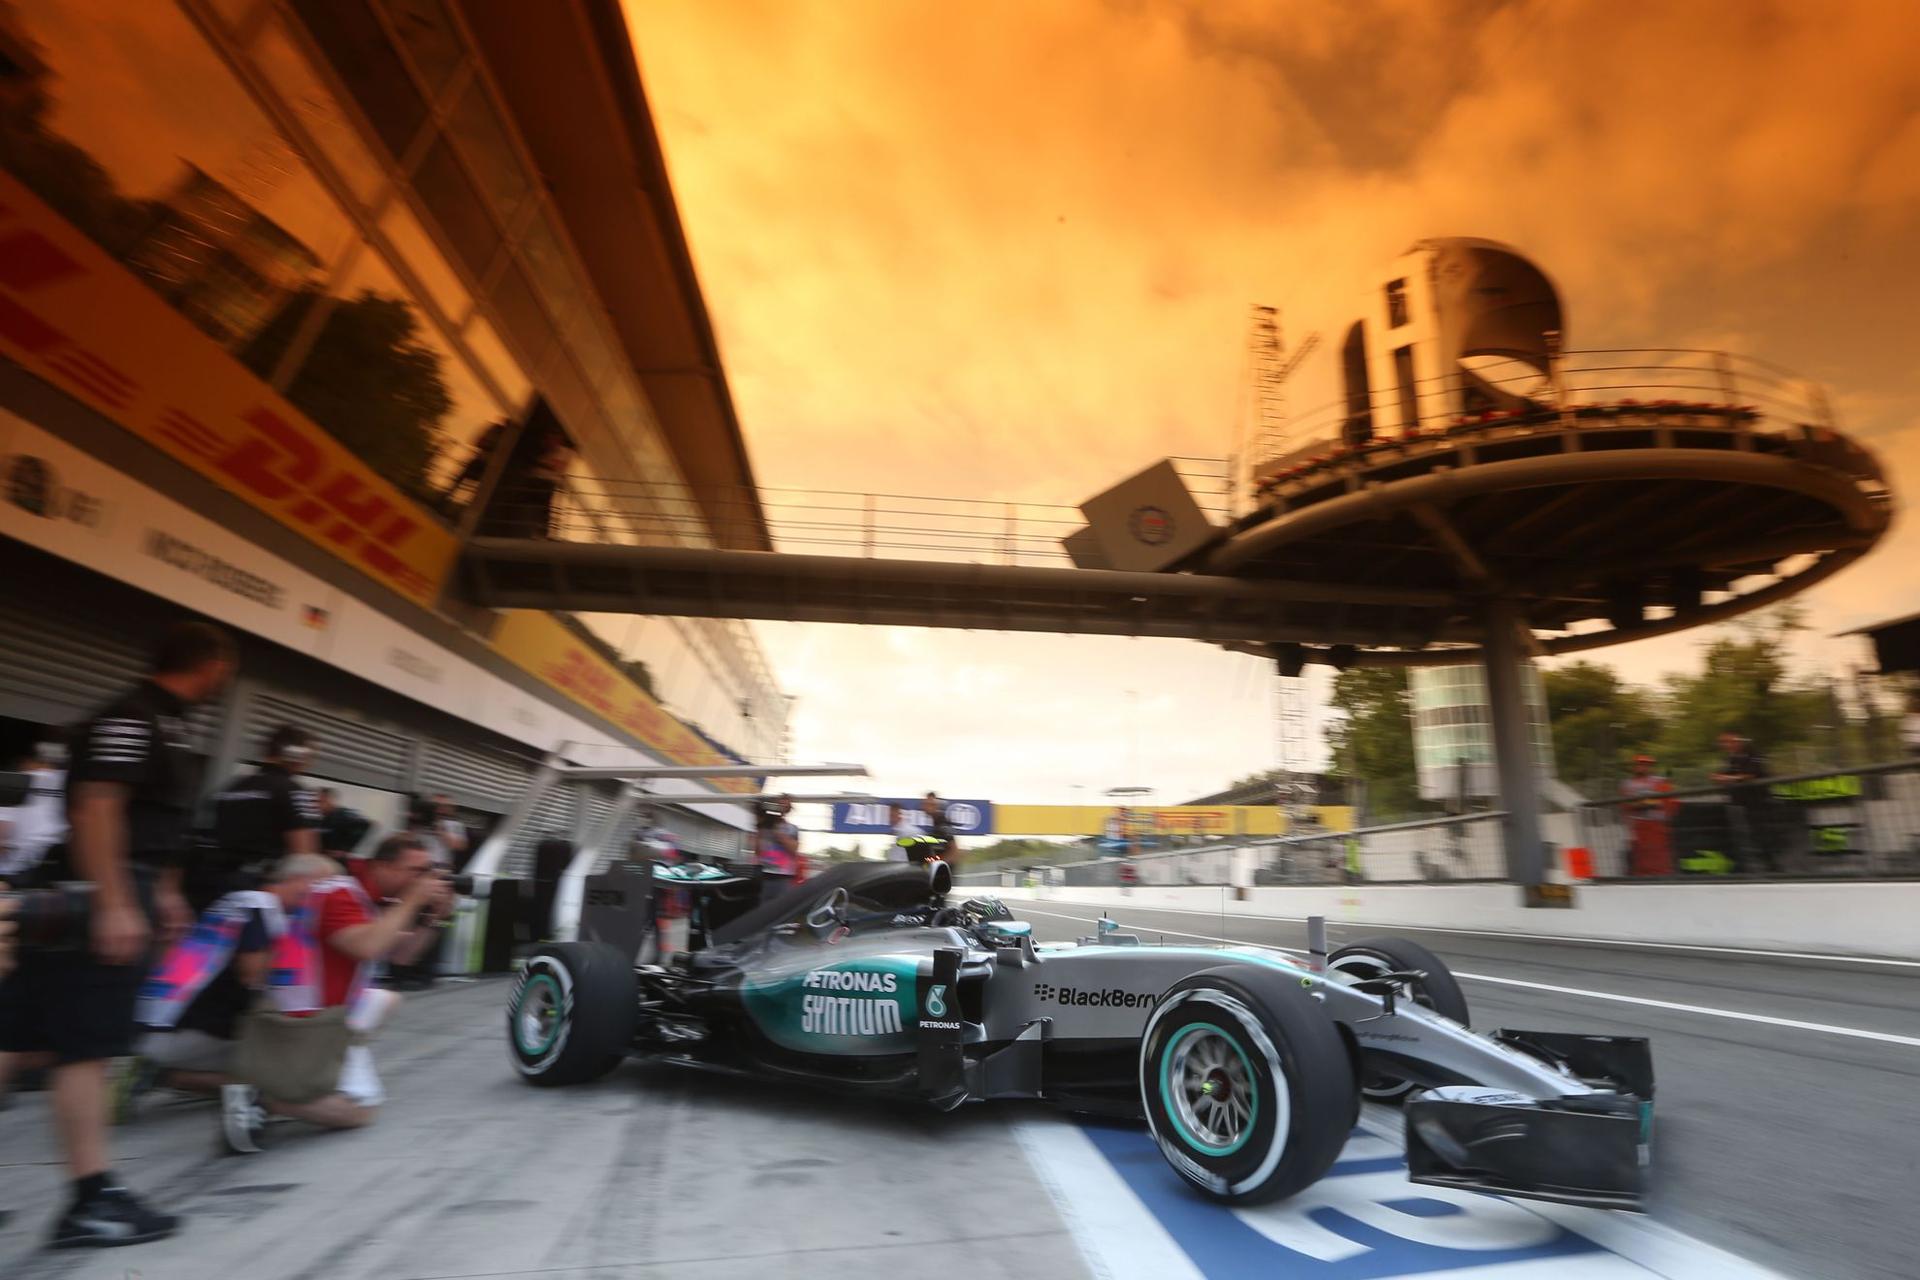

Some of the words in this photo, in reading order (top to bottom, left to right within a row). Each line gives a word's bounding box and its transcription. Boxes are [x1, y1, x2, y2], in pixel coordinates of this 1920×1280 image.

[802, 971, 897, 992] PETRONAS
[1058, 987, 1162, 1008] BlackBerry
[919, 1020, 961, 1030] PETRONAS
